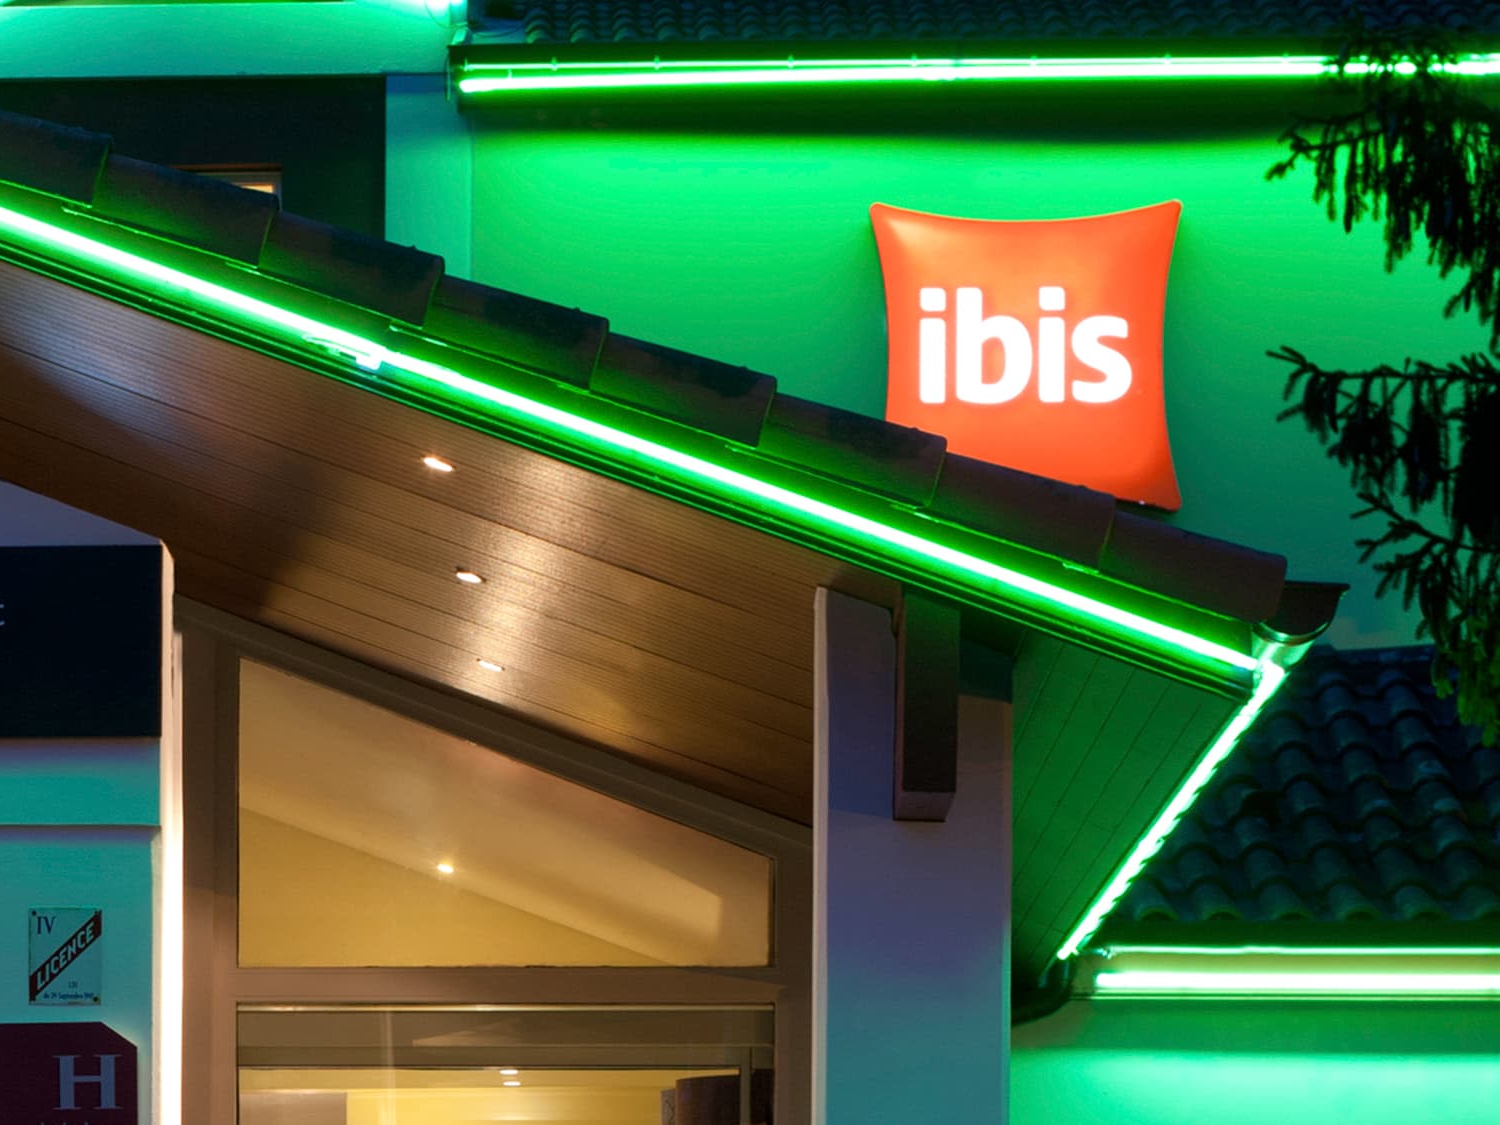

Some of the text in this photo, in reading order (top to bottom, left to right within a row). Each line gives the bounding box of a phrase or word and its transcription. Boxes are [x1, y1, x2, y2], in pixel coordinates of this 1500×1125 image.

[919, 286, 1133, 404] ibis
[36, 920, 95, 991] LICENCE
[37, 916, 56, 935] IV
[53, 1054, 124, 1110] H
